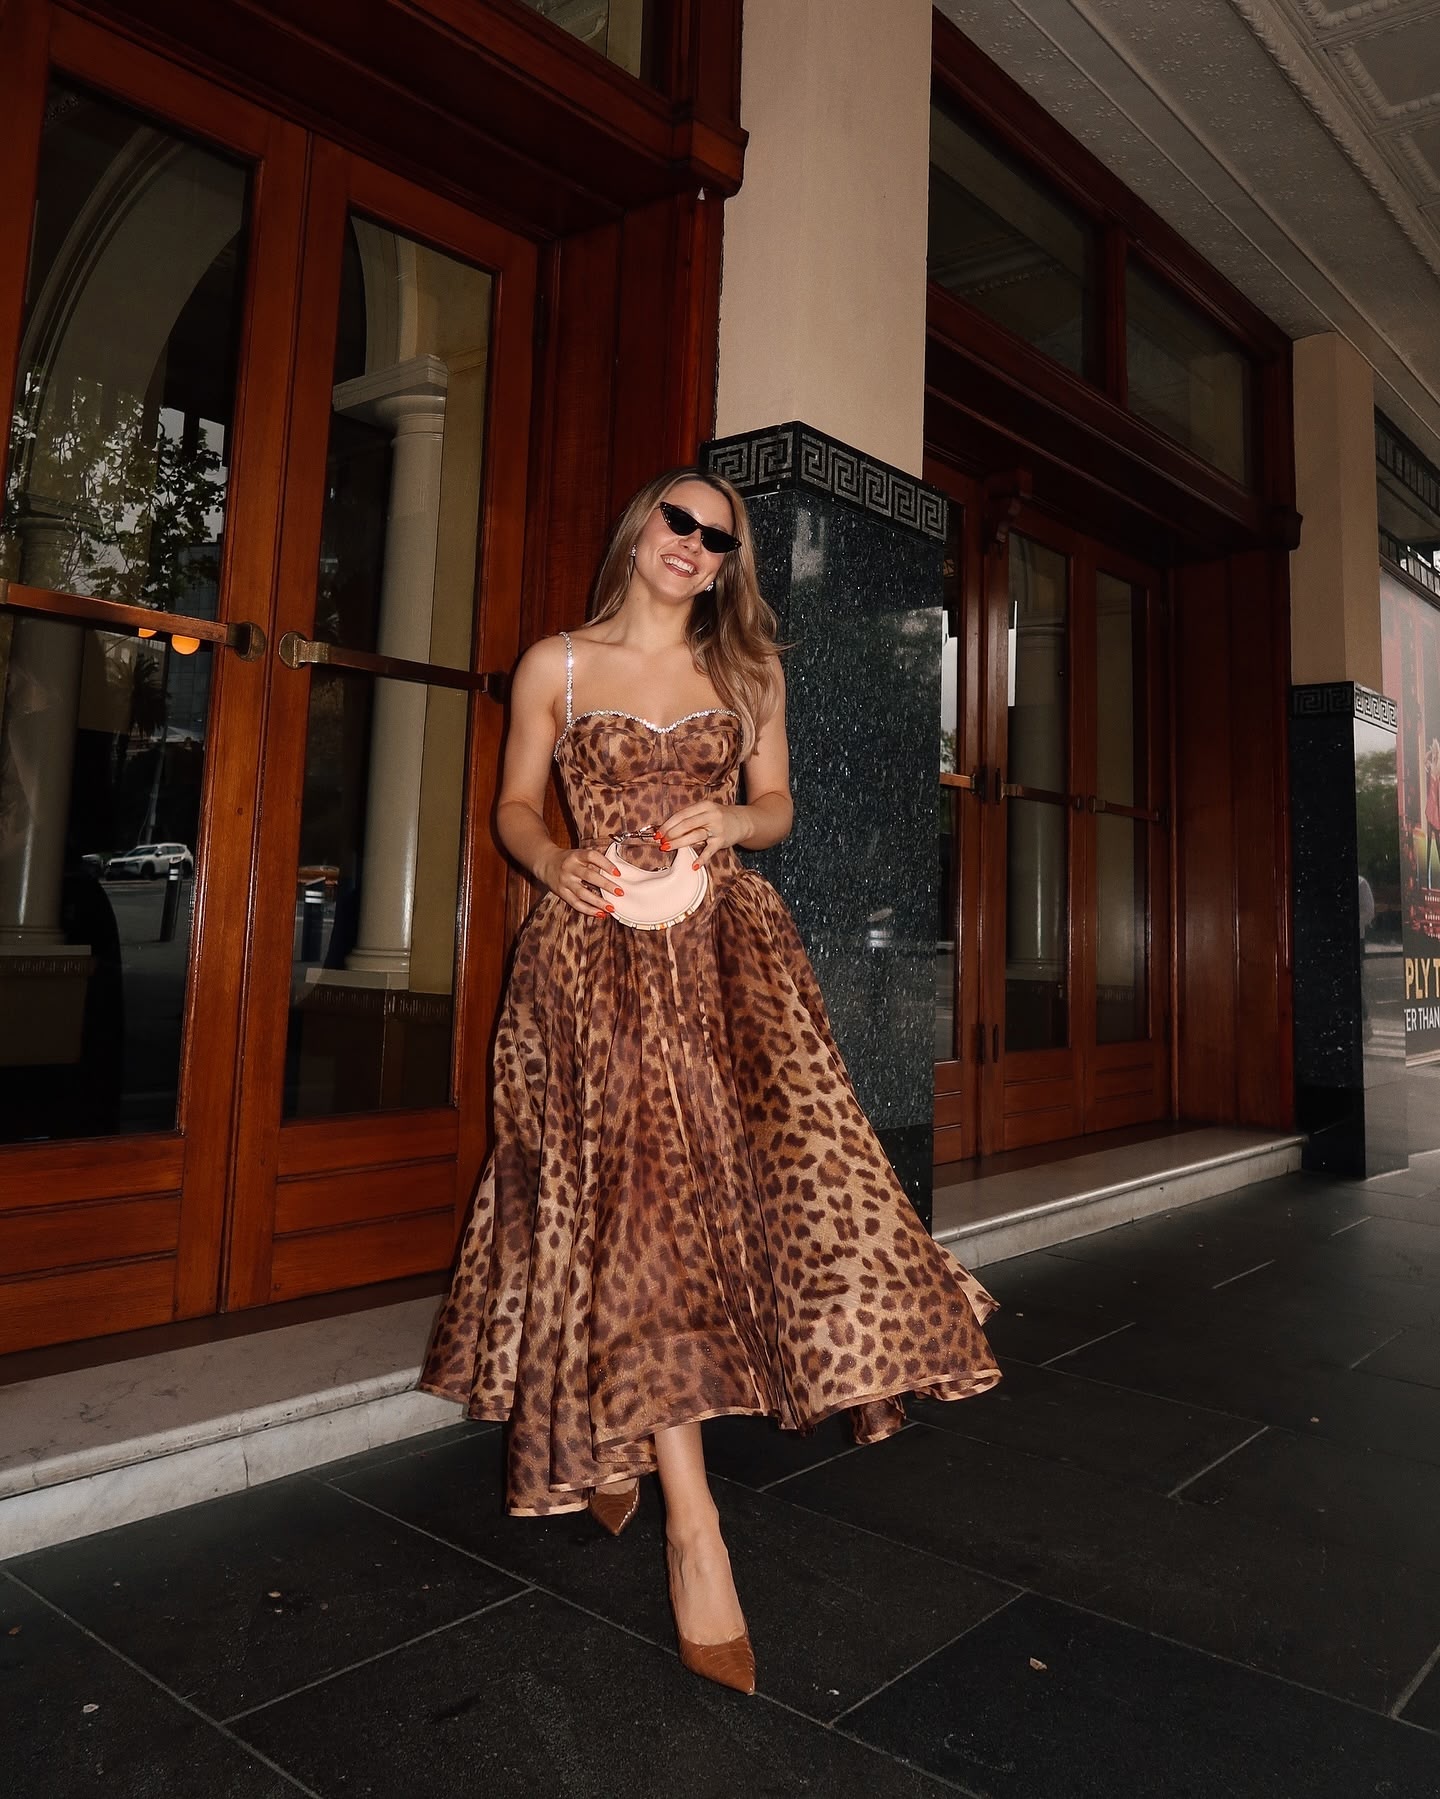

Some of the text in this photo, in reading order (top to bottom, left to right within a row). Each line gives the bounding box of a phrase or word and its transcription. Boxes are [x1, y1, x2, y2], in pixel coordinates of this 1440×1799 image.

[1405, 958, 1430, 1000] PLY
[1404, 1006, 1440, 1032] ER THAN
